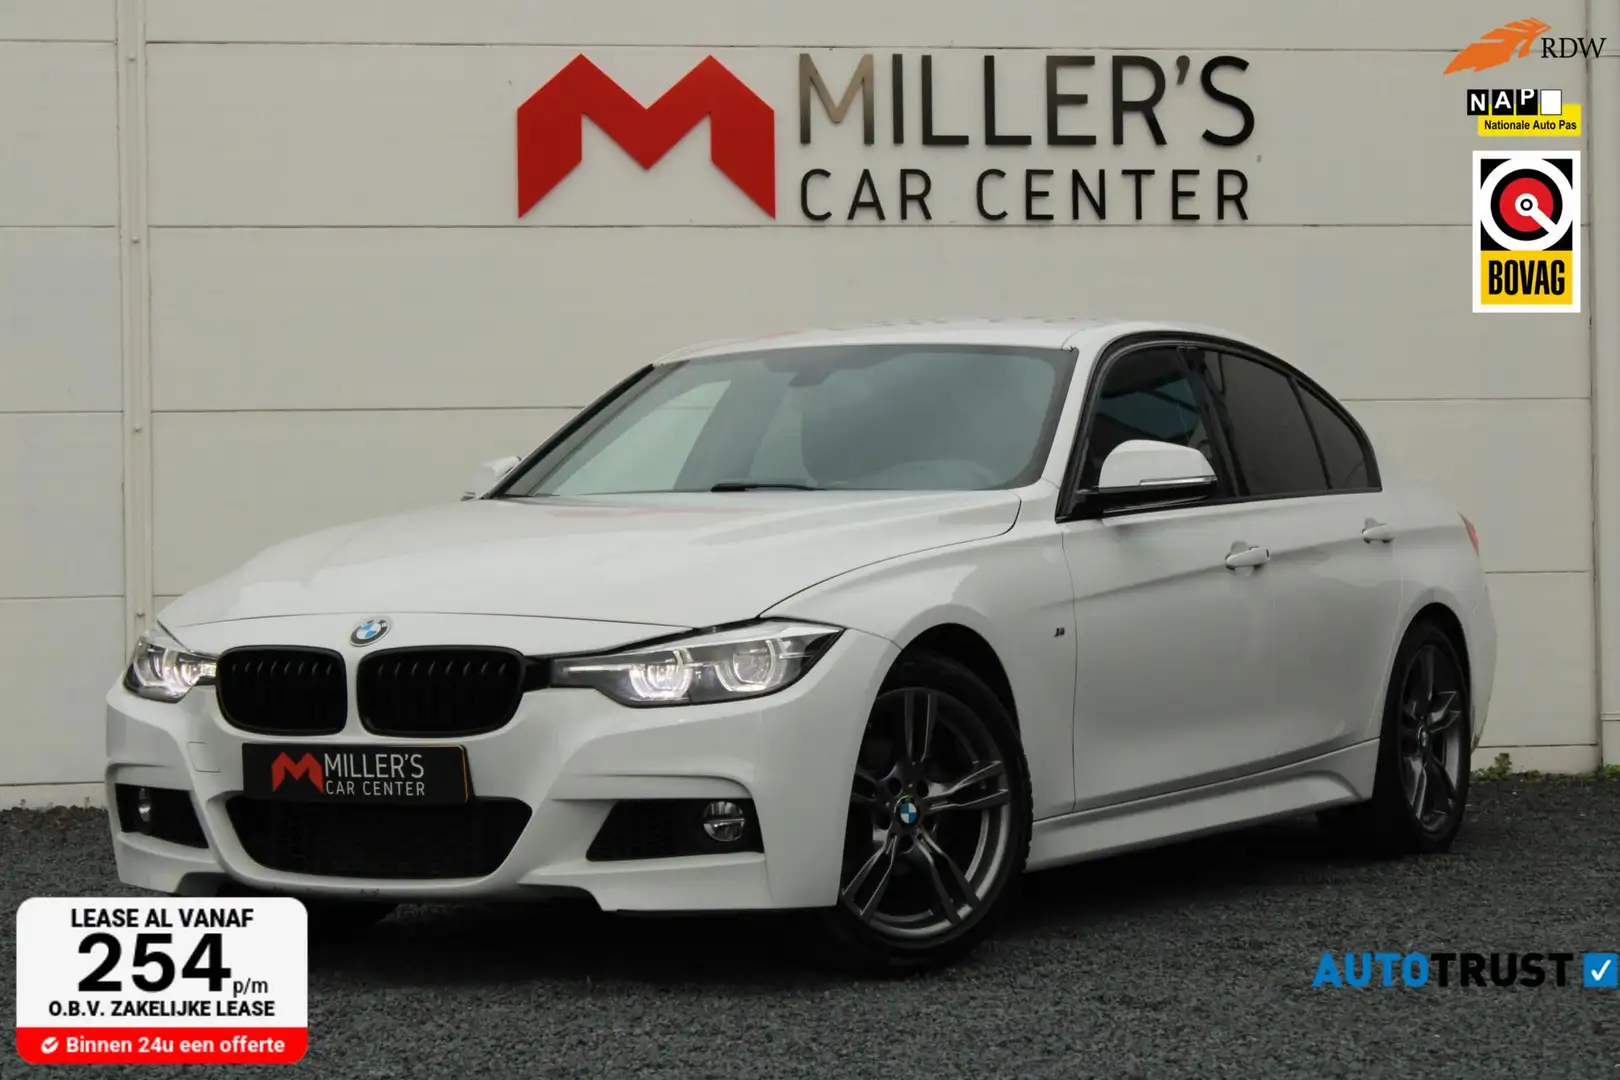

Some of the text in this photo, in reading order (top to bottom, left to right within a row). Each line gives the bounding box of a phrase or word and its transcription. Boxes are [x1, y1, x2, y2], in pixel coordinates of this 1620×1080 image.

[800, 53, 1255, 147] MILLER'S
[800, 167, 1249, 221] CAR CENTER
[324, 753, 425, 779] MILLER'S
[325, 780, 425, 797] CAR CENTER
